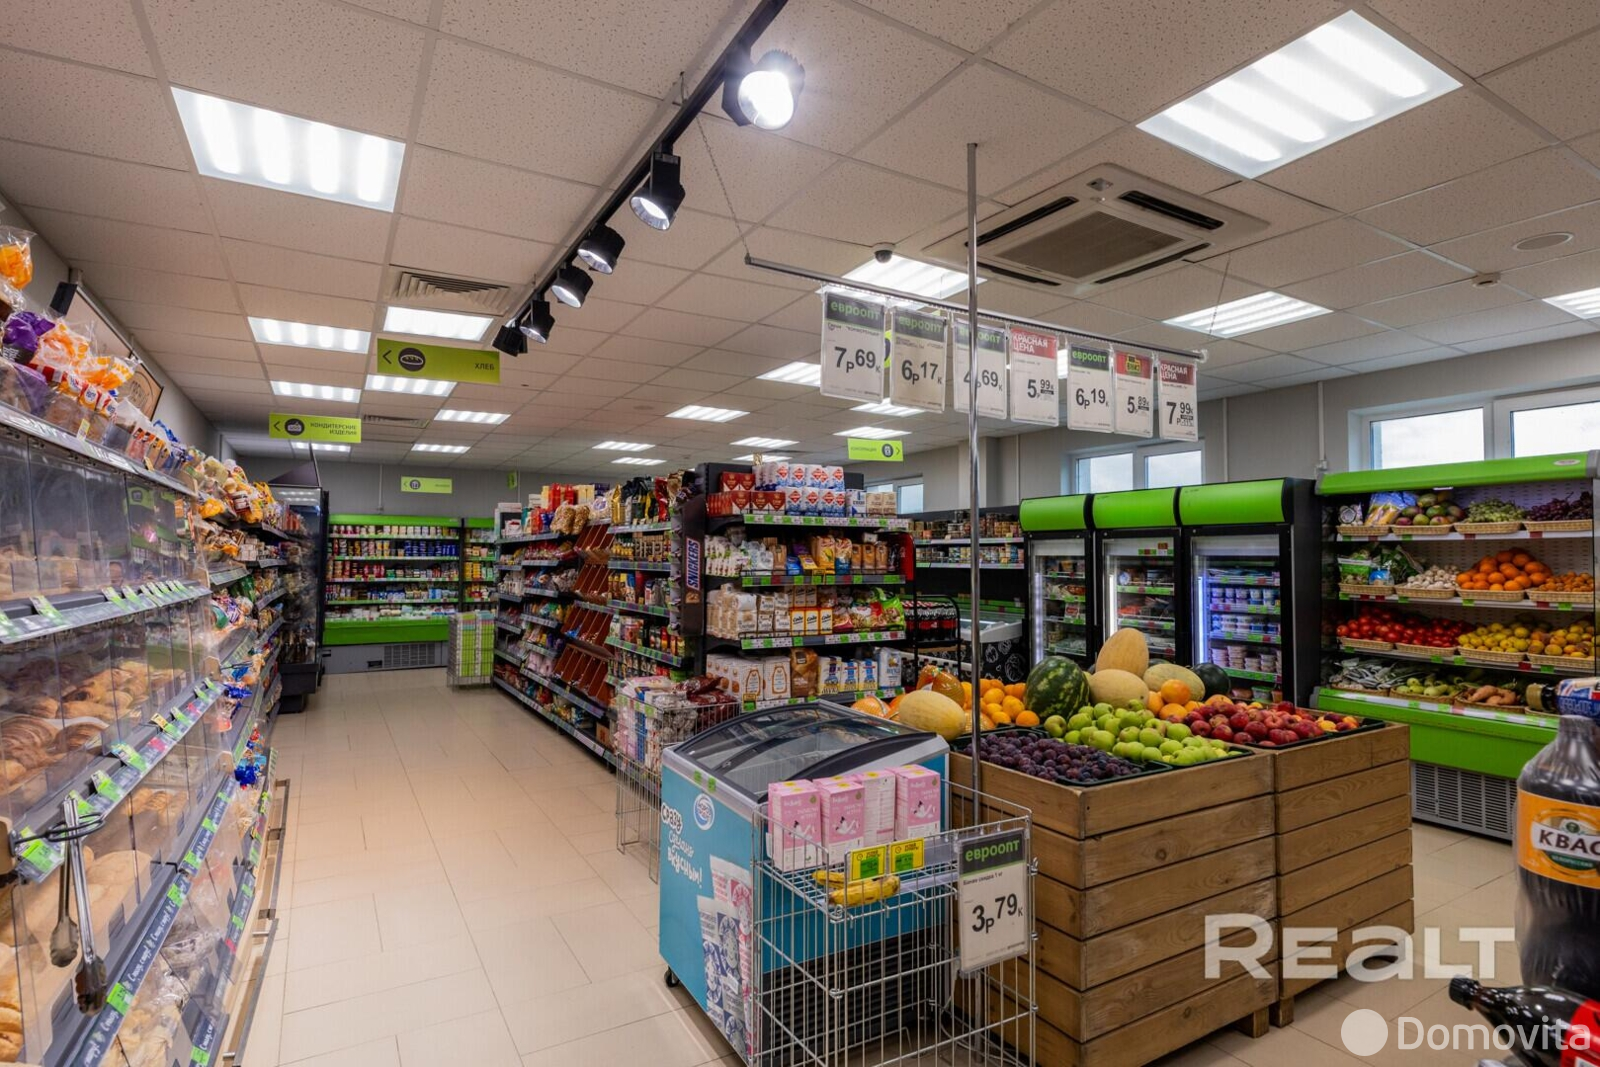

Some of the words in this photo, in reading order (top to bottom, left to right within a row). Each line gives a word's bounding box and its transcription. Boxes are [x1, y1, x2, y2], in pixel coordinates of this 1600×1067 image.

[830, 301, 880, 321] евроопт
[897, 315, 943, 335] евроопт
[1012, 333, 1048, 348] КРАСНАЯ
[1012, 341, 1035, 354] ЦЕНА
[1072, 350, 1107, 364] евроопт
[474, 361, 495, 371] ХЛЕБ
[1160, 363, 1188, 376] КРАСНАЯ
[1160, 371, 1178, 381] ЦЕНА
[688, 540, 699, 588] SNICKERS
[1539, 829, 1600, 856] КВАС
[965, 840, 1020, 861] евроопт
